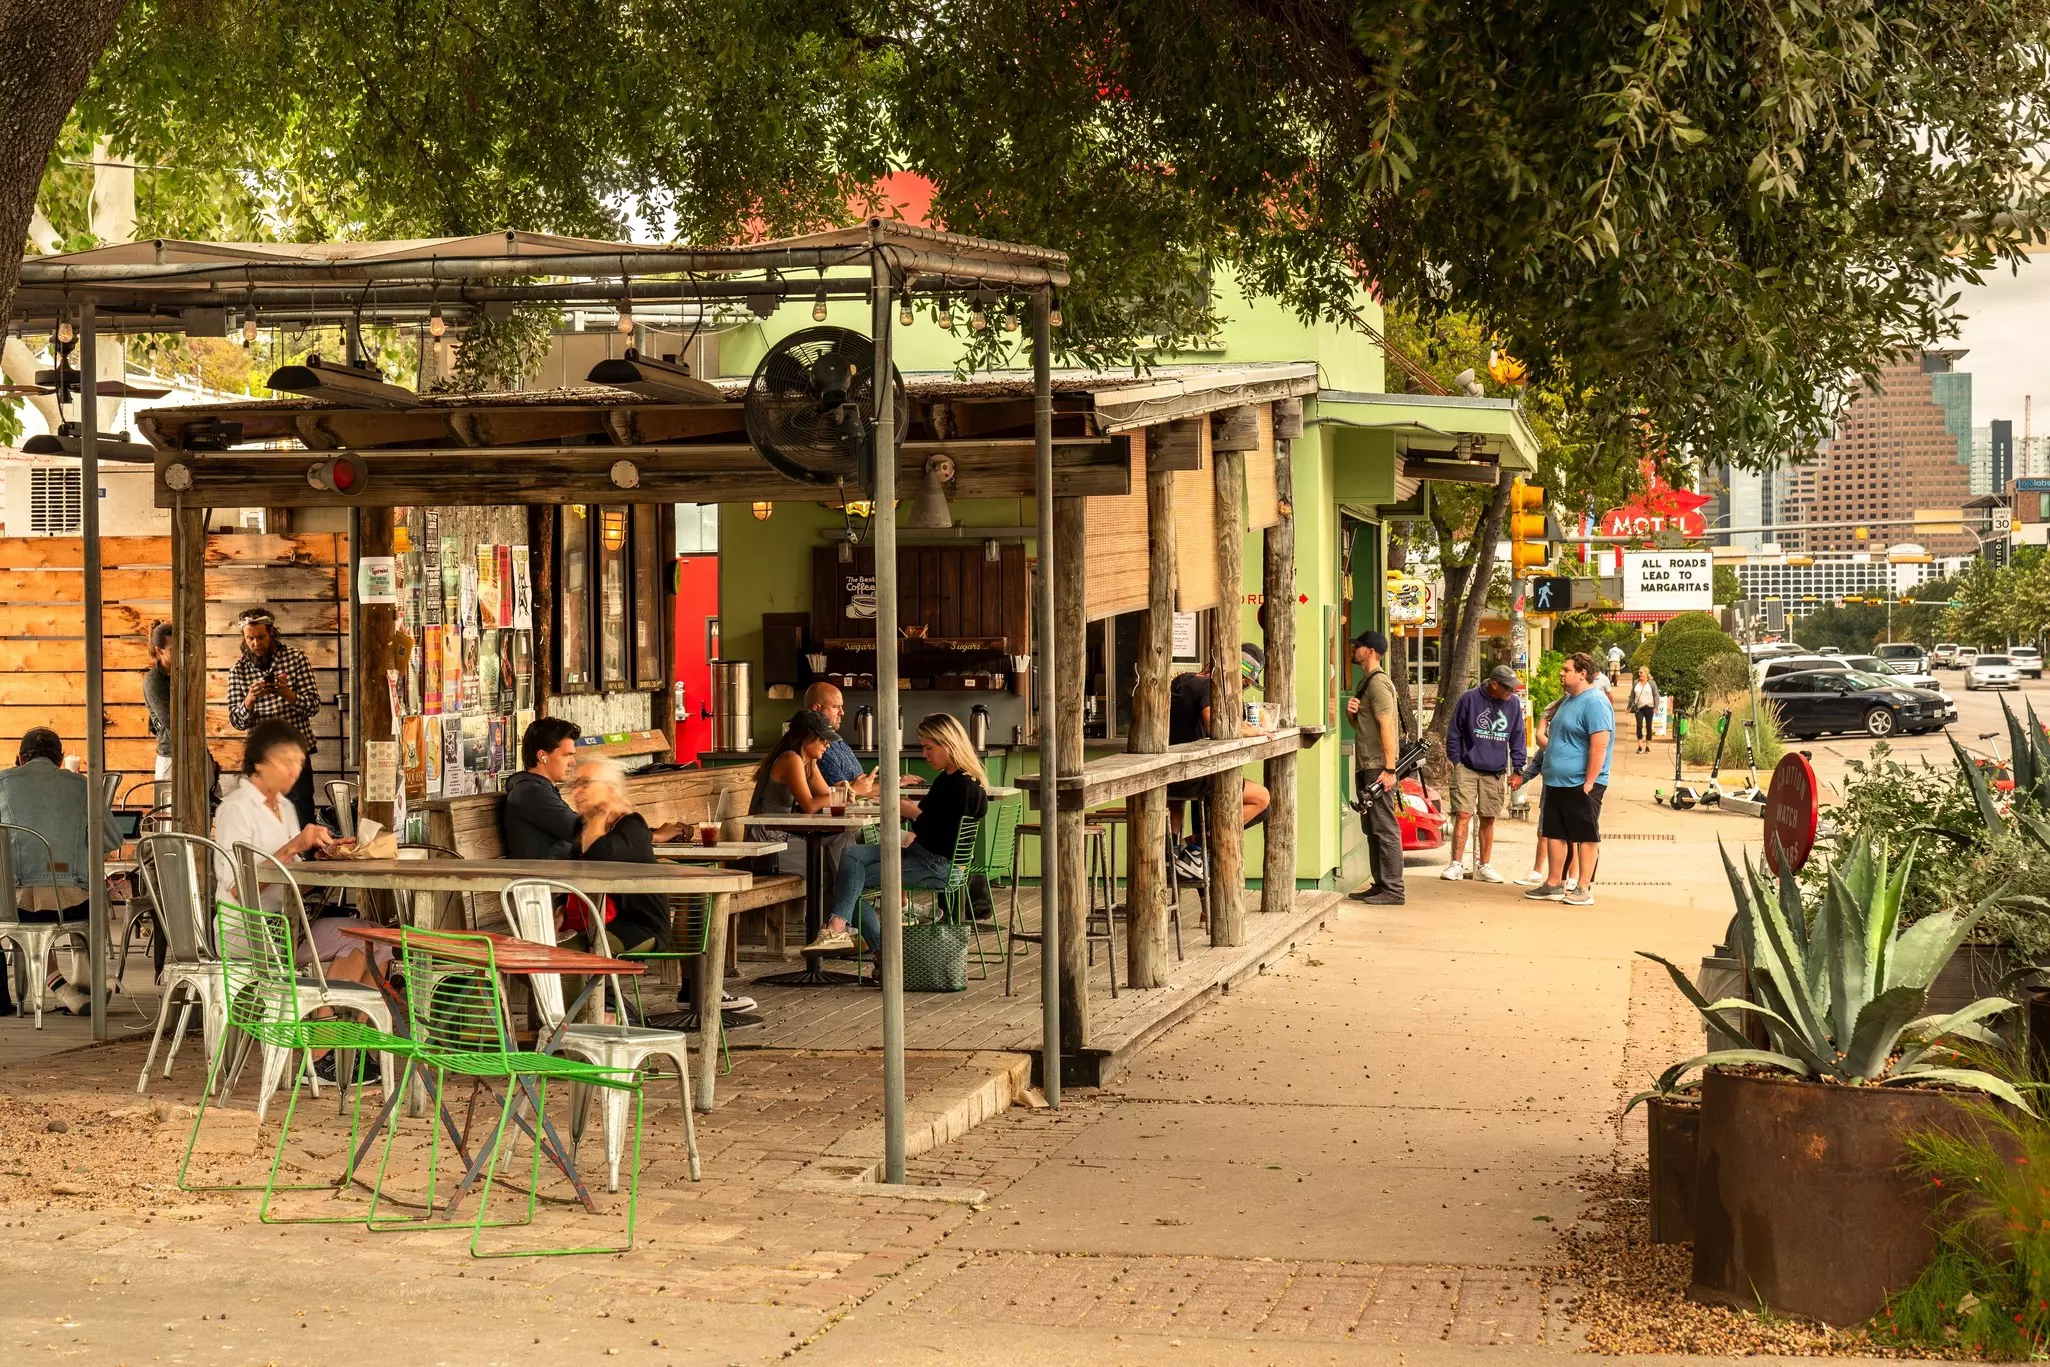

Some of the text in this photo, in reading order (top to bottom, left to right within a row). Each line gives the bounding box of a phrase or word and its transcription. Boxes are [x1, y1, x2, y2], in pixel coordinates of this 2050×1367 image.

[1995, 520, 2009, 529] 30
[1641, 559, 1706, 568] ALL ROADS
[859, 575, 876, 583] Best
[1642, 571, 1692, 580] LEAD TO
[846, 583, 876, 592] Coffee
[1641, 583, 1709, 592] MARGARITAS
[1776, 765, 1806, 800] CAUTION
[1776, 803, 1798, 828] WATCH
